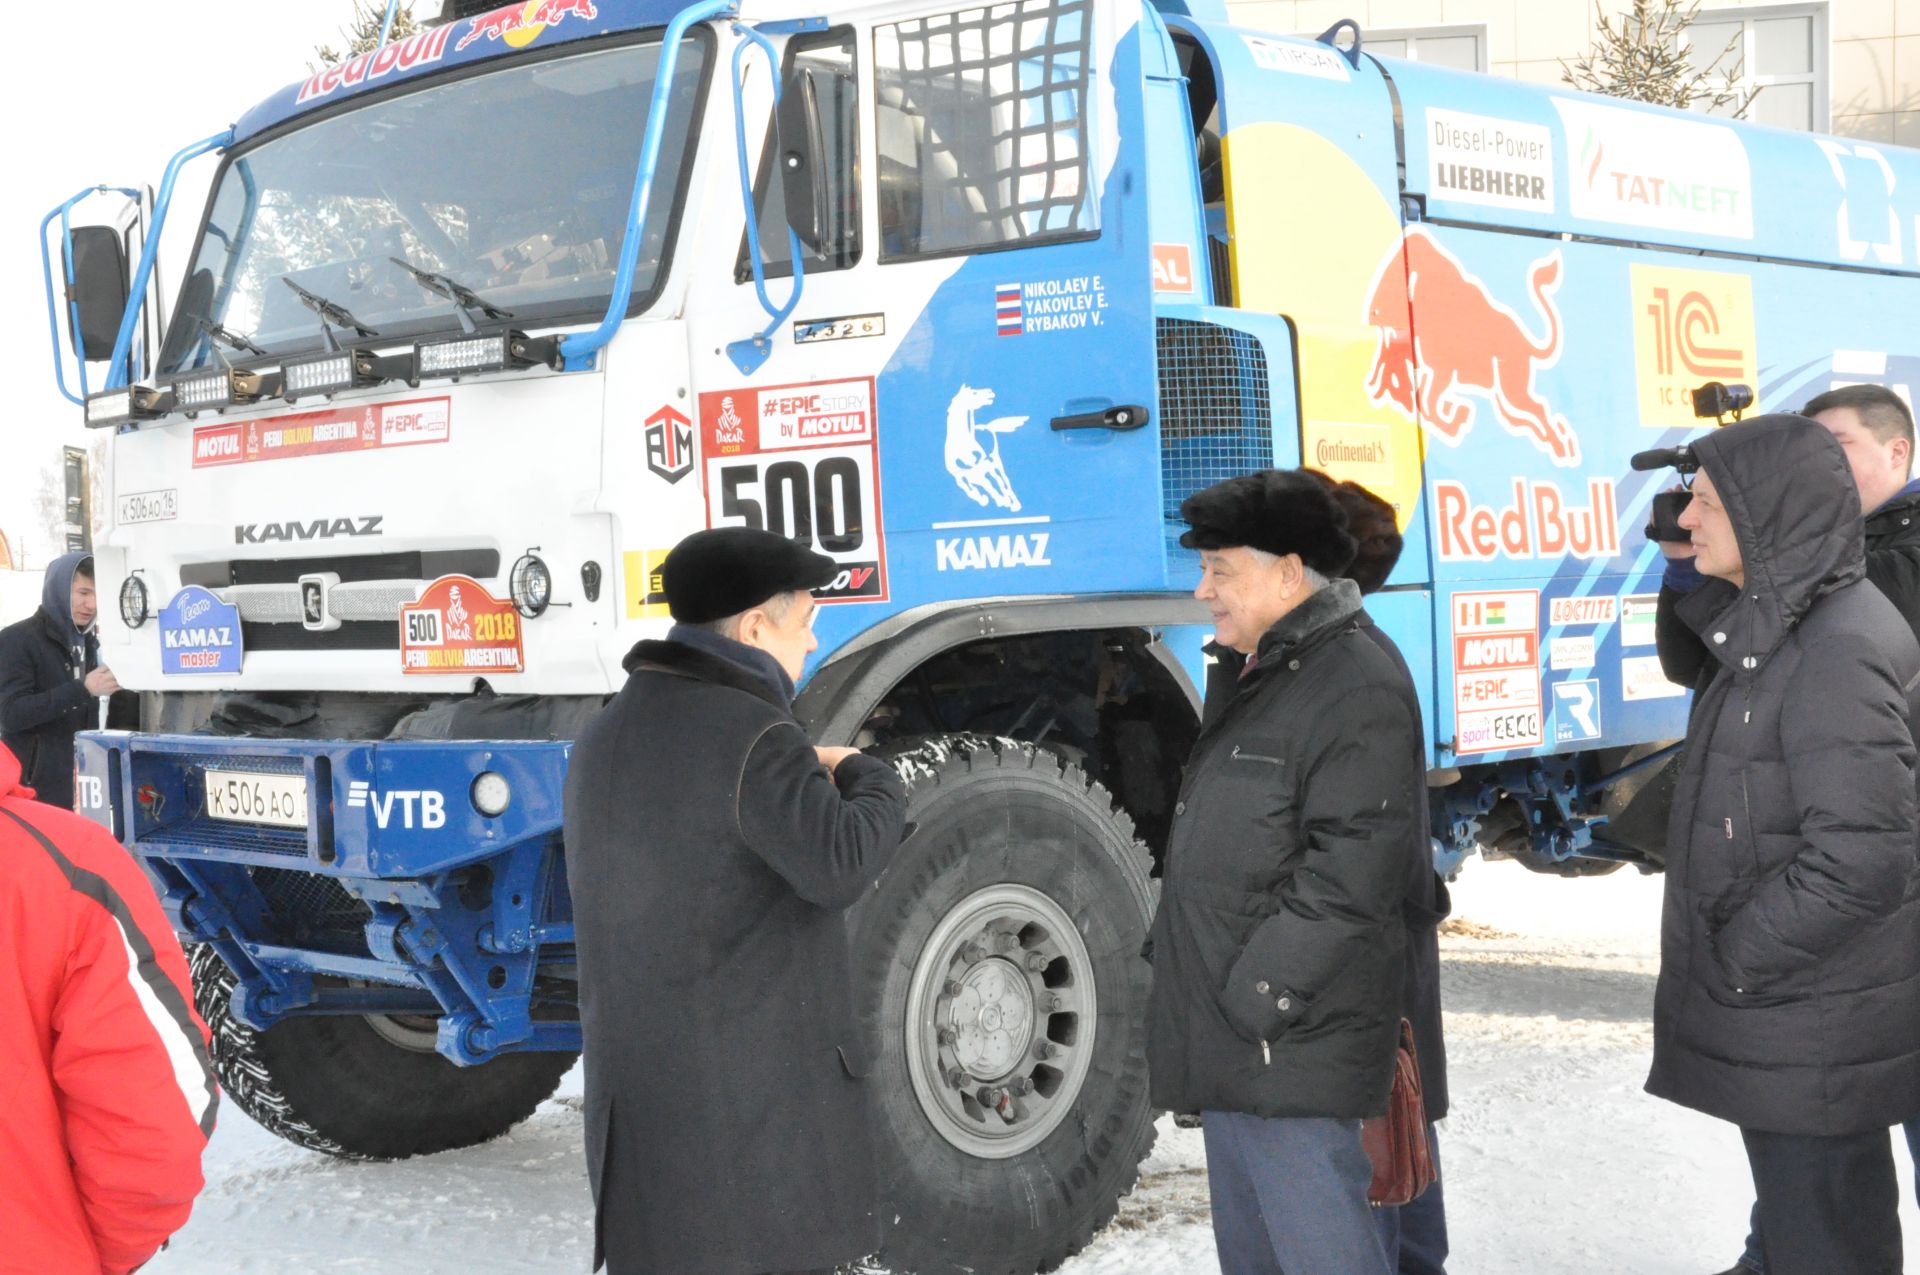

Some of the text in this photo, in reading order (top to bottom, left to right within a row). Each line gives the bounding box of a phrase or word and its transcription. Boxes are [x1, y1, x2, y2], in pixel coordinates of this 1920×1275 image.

[1434, 120, 1544, 160] Diesel-Power
[1437, 162, 1546, 200] LIEBHERR
[1610, 171, 1740, 216] TATNEFT
[1024, 275, 1105, 298] NIKOLAEV E.
[1025, 293, 1109, 315] YAKOVLEV E.
[1026, 310, 1104, 333] RYBAKOV V.
[313, 421, 358, 442] ARGENTINA
[780, 414, 864, 439] by MOTUL
[197, 434, 240, 458] MOTUL
[1316, 438, 1378, 467] Continental
[720, 456, 864, 554] 500
[1437, 481, 1617, 556] Red Bull
[235, 515, 383, 544] KAMAZ
[936, 533, 1052, 571] KAMAZ
[177, 592, 211, 625] Team
[1552, 599, 1615, 622] LOCTITE
[164, 627, 233, 649] KAMAZ
[408, 613, 438, 642] 500
[474, 613, 516, 641] 2018
[180, 650, 221, 668] master
[405, 648, 519, 667] PERU BOLIVIA ARGENTINA
[1462, 636, 1529, 667] MOTUL
[1461, 726, 1491, 746] sport
[78, 775, 103, 809] TB
[369, 790, 446, 829] VTB
